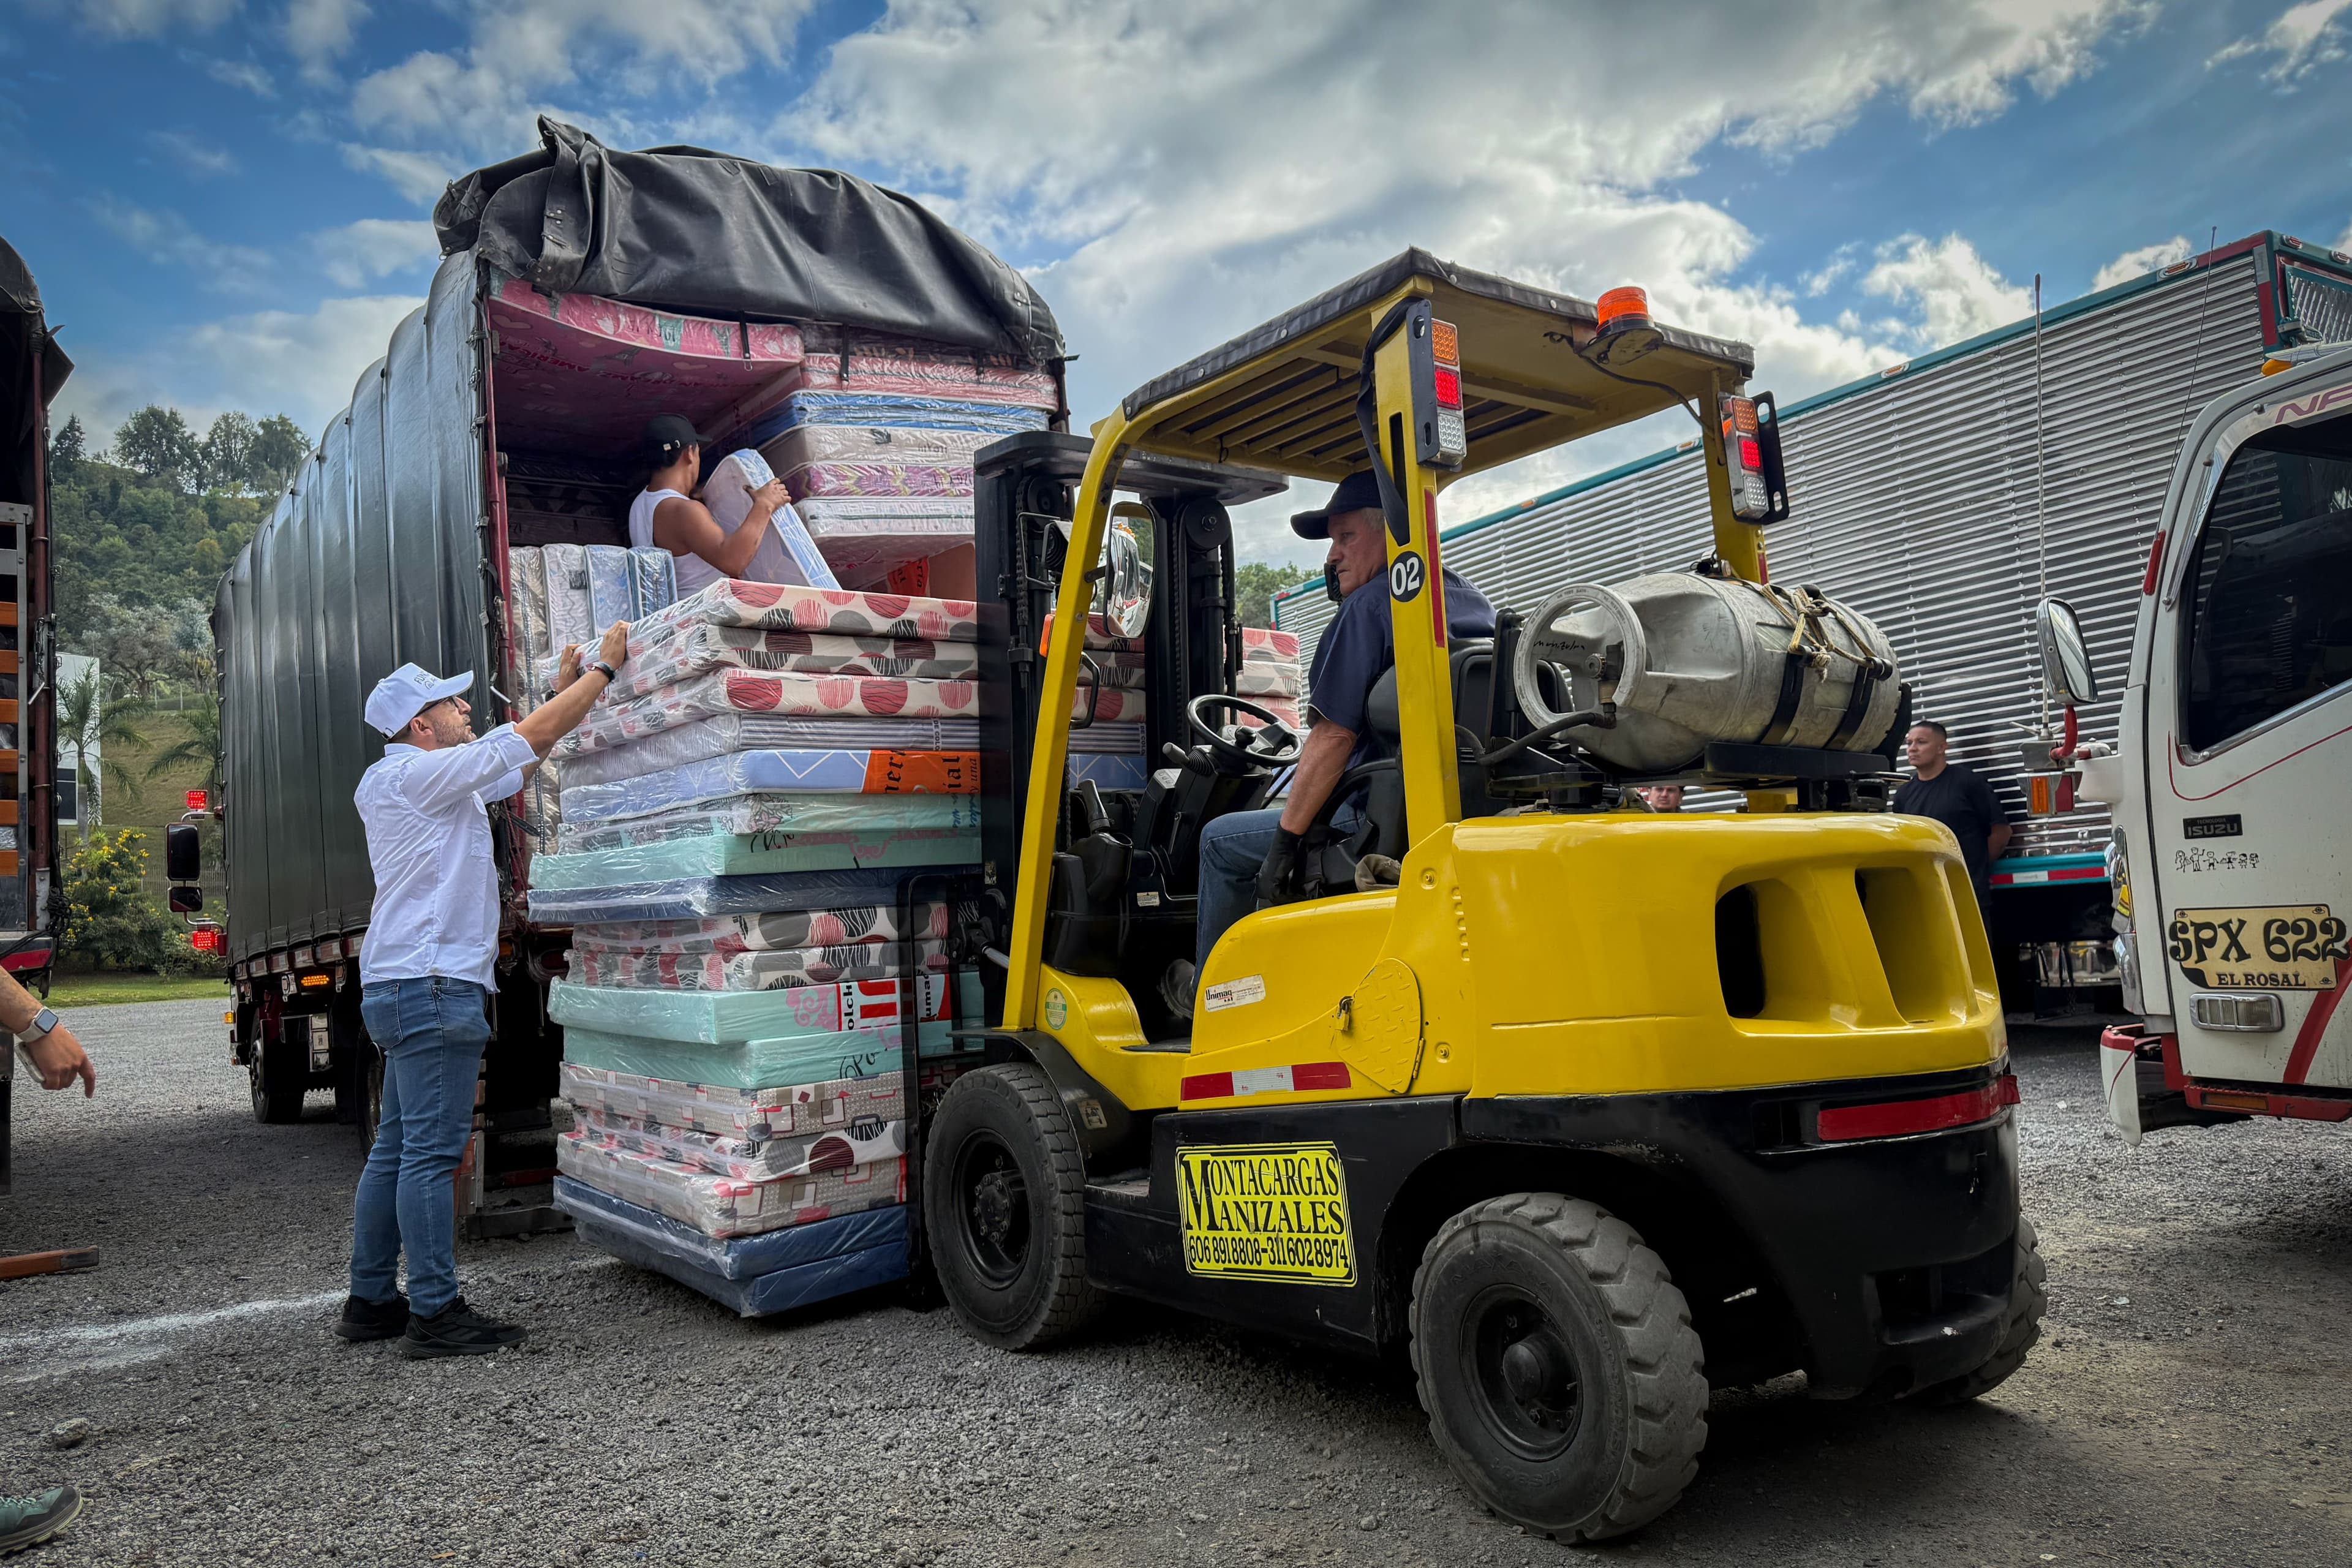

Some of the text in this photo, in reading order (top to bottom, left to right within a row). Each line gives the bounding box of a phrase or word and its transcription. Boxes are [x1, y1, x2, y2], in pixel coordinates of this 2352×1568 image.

[1391, 556, 1420, 596] 02
[2187, 823, 2238, 837] ISUZU
[2169, 917, 2352, 963] SPX 622
[2217, 971, 2307, 987] EL ROSAL
[1205, 988, 1233, 1001] Unimaq
[1182, 1157, 1340, 1204] MONTACARGAS
[1189, 1235, 1212, 1264] 606
